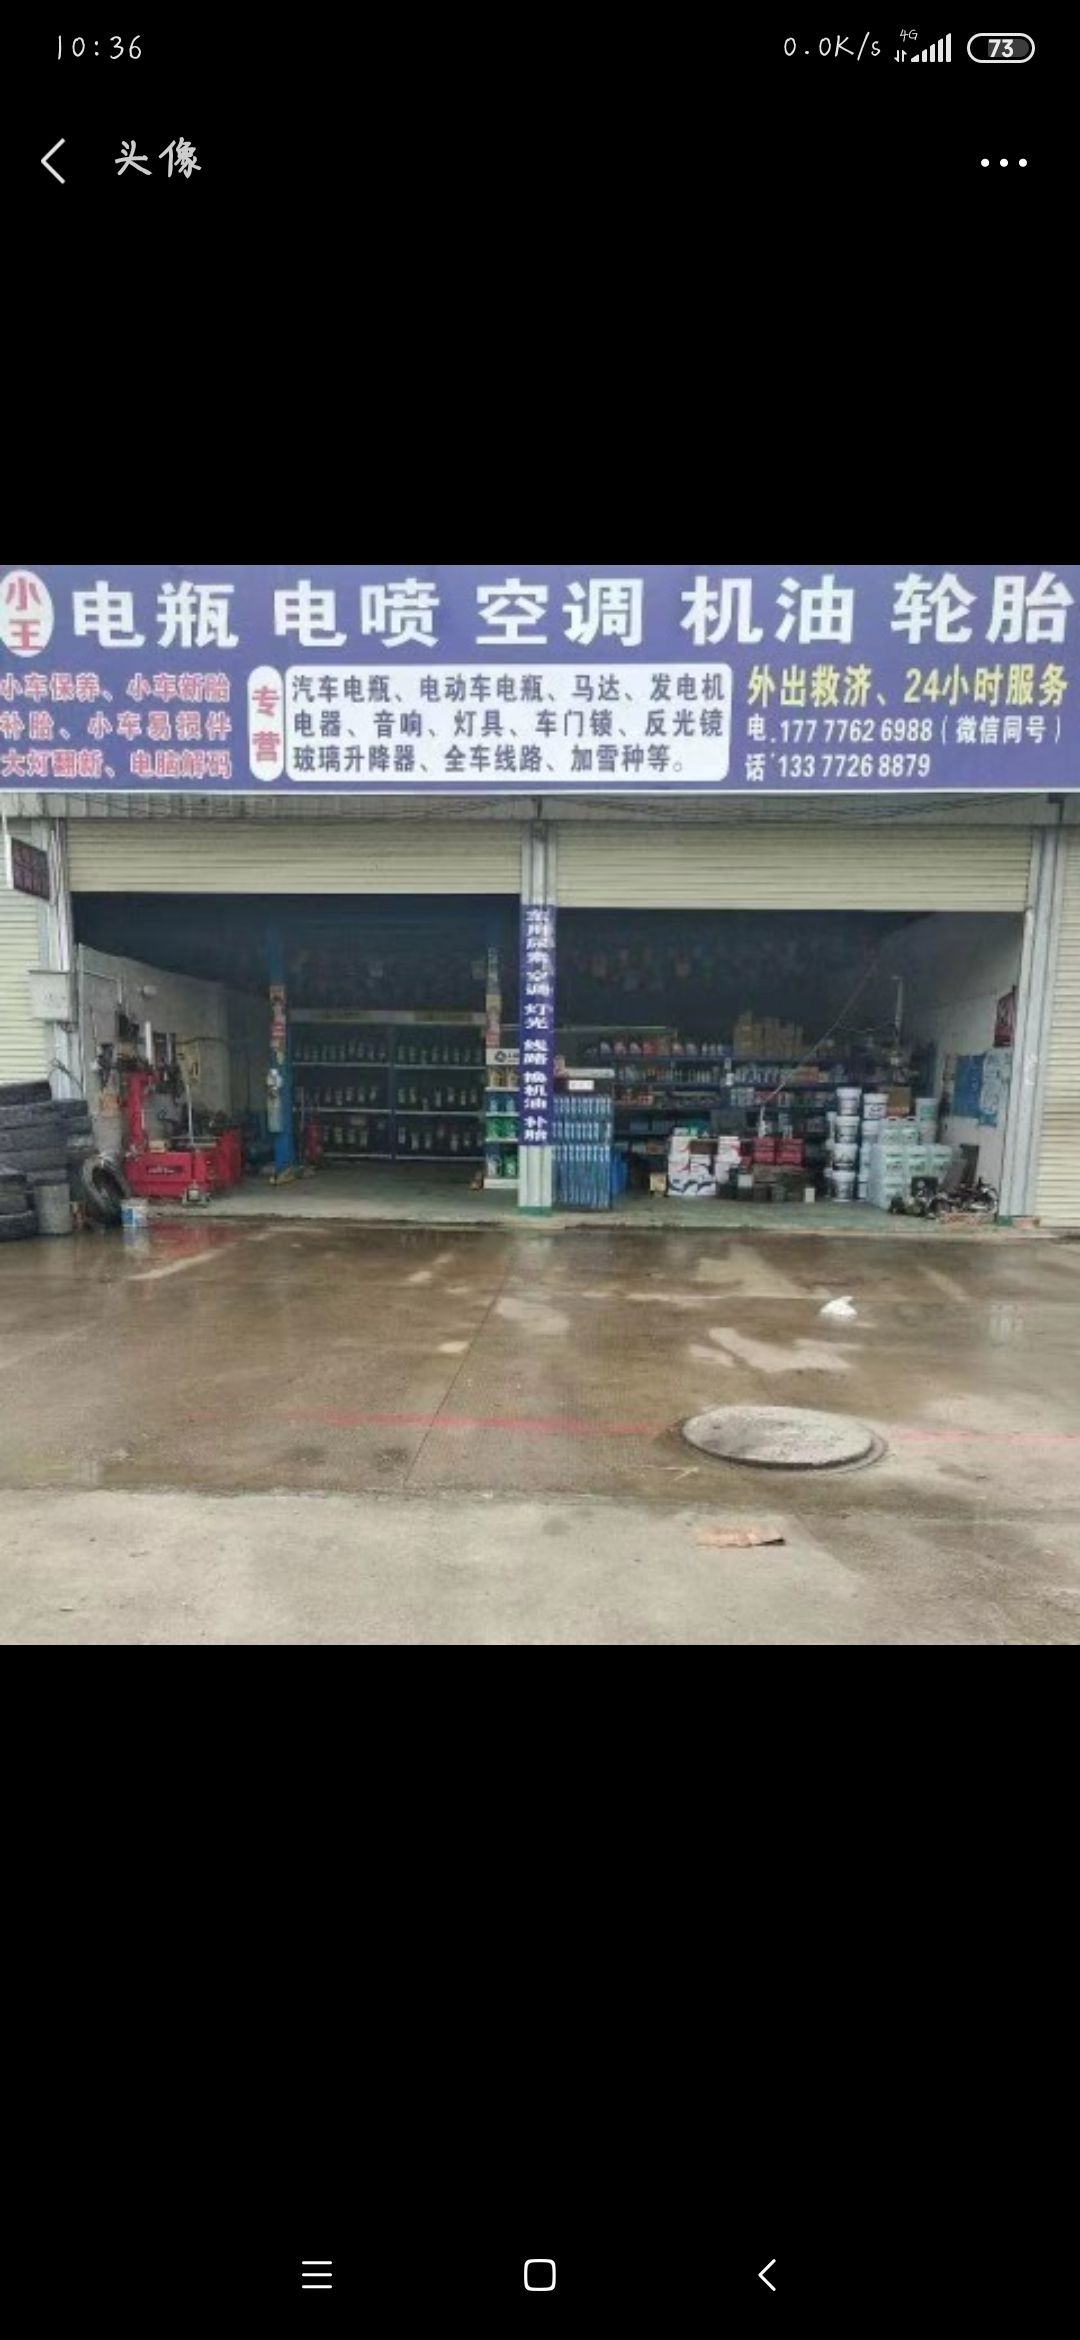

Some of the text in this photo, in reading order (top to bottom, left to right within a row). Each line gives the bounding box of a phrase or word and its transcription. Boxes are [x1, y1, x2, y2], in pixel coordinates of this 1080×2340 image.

[5, 577, 42, 652] 小王
[72, 571, 1075, 649] 电瓶 电喷 空调 机油 轮胎
[292, 673, 725, 703] 汽车电瓶、电动车电瓶、马达、发电机
[747, 662, 1068, 708] 外出救济、24小时服务
[252, 686, 280, 763] 专营
